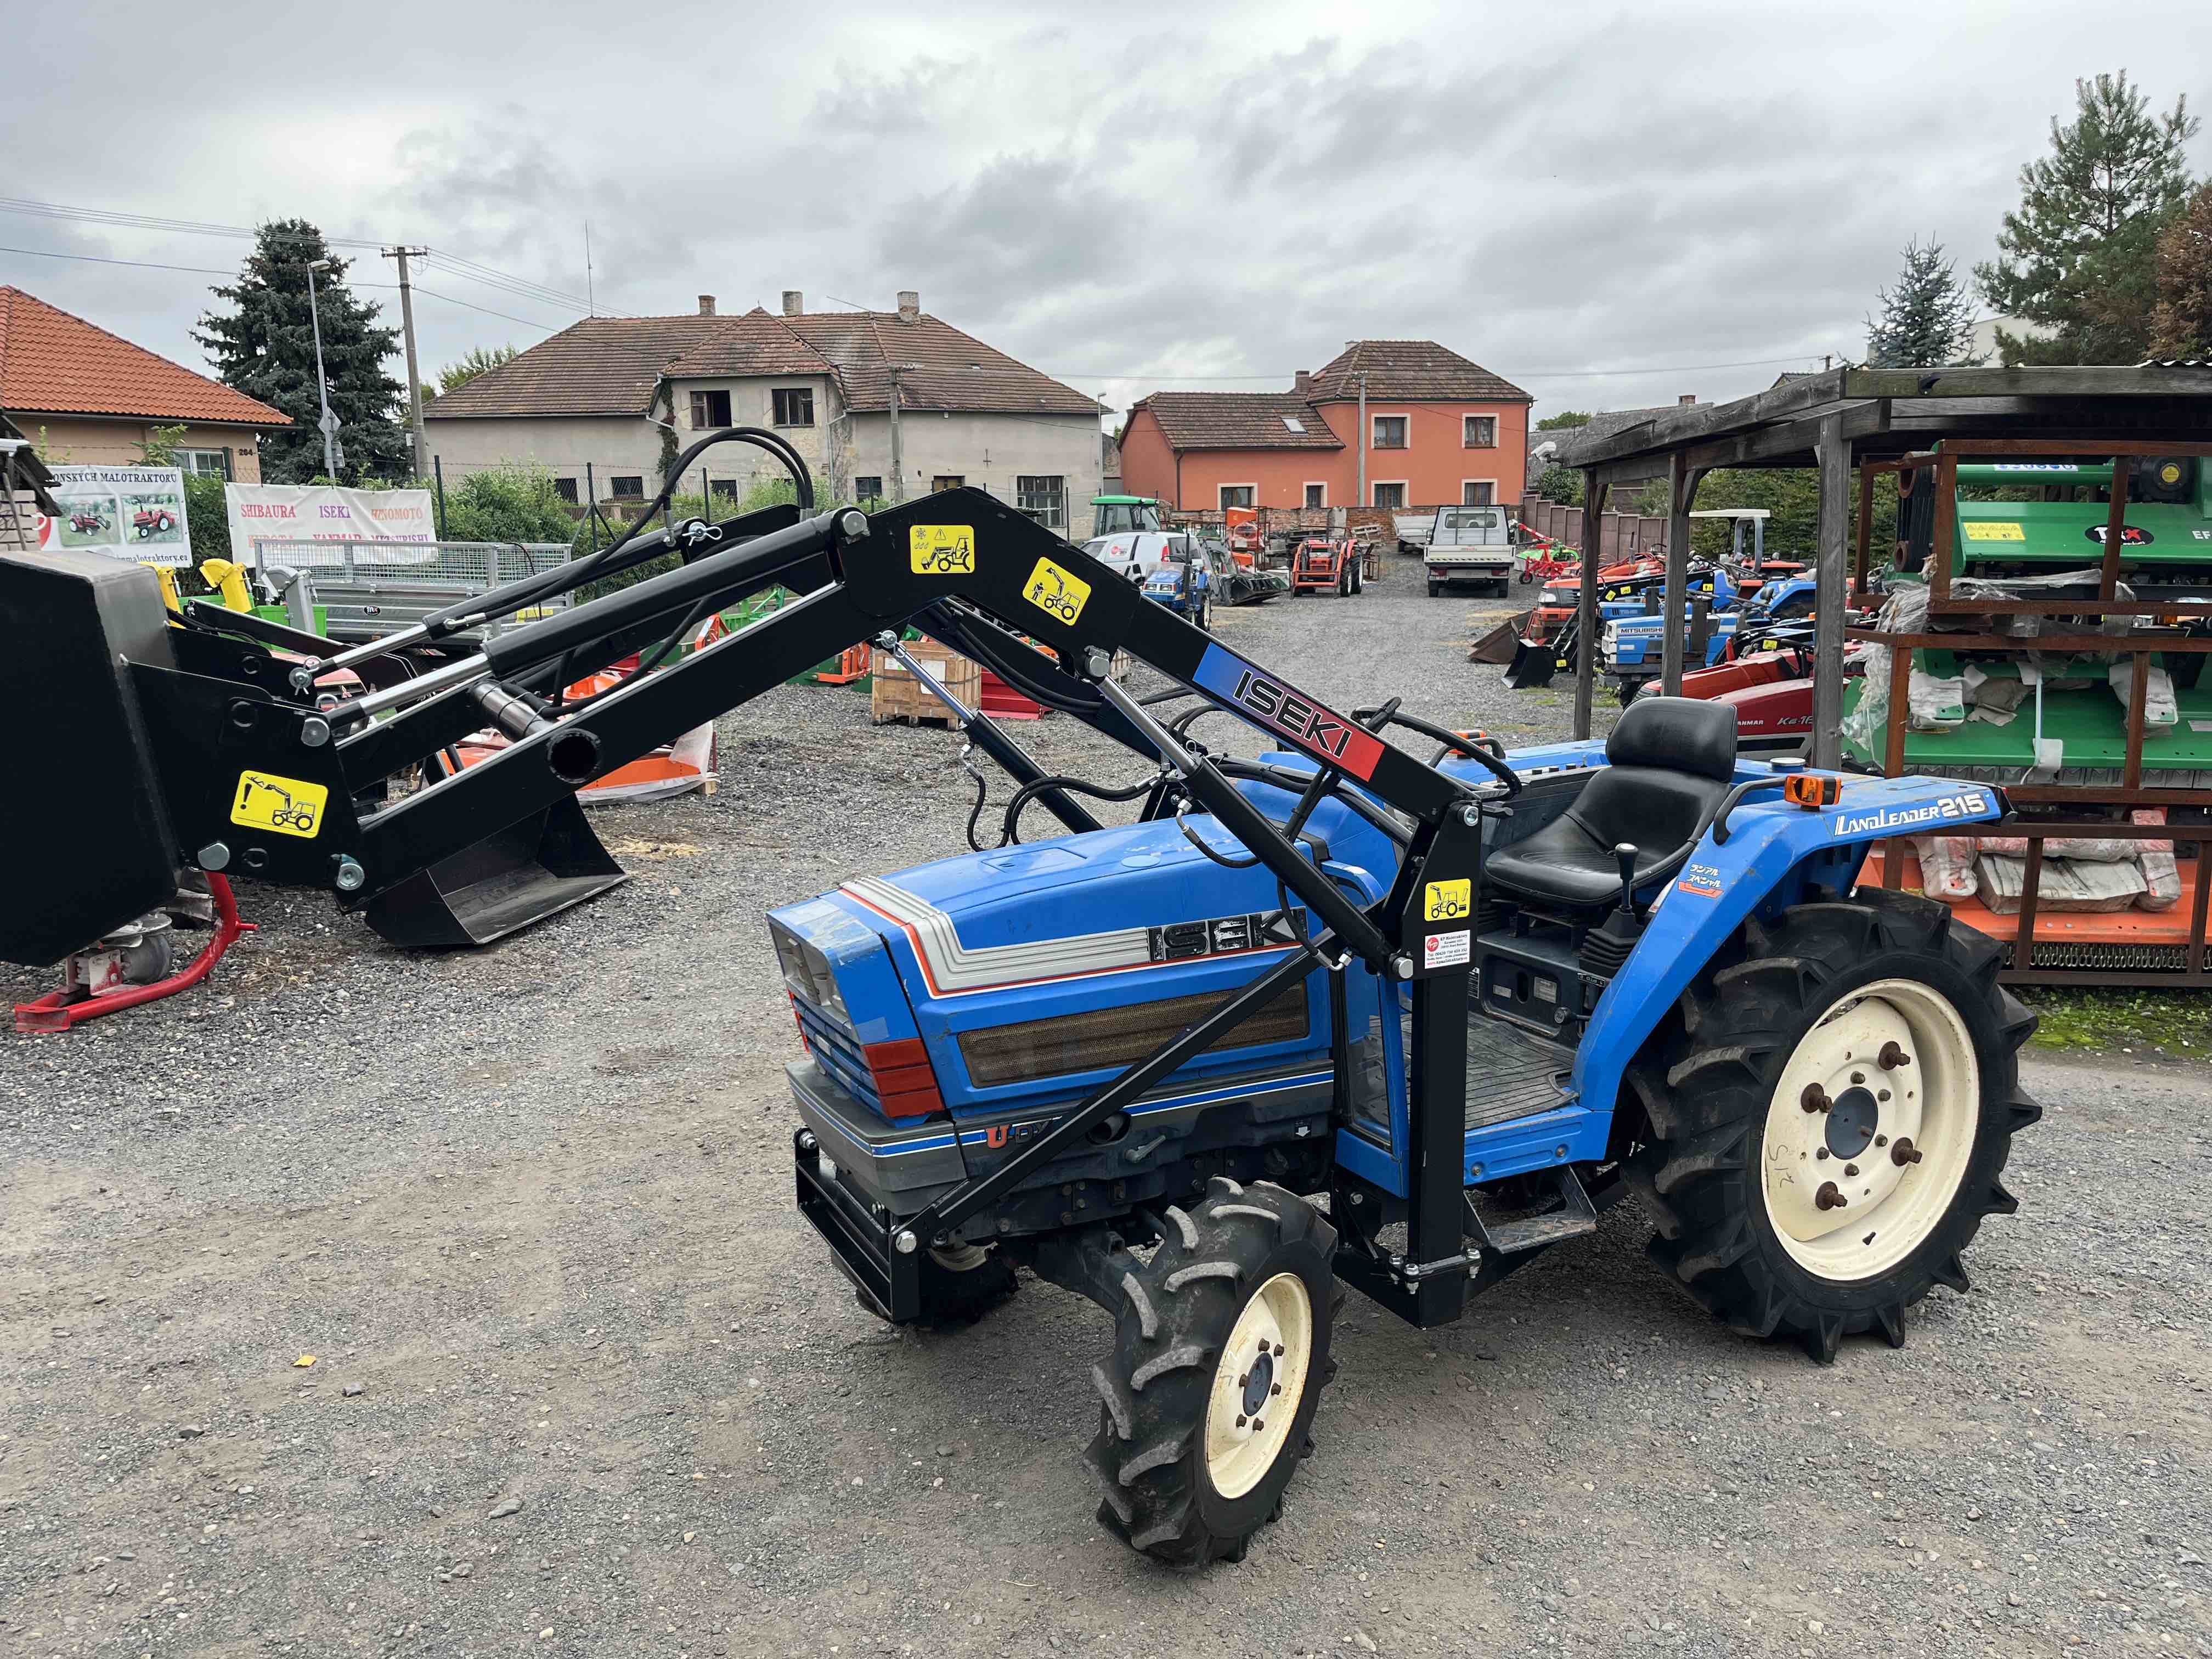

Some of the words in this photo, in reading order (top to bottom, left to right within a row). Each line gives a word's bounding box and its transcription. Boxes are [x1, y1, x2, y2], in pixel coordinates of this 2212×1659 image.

[241, 504, 296, 518] SHIBAURA
[319, 505, 351, 518] ISEKI
[1233, 669, 1352, 759] ISEKI
[1937, 793, 1985, 817] 215
[1149, 907, 1308, 962] ISEKI
